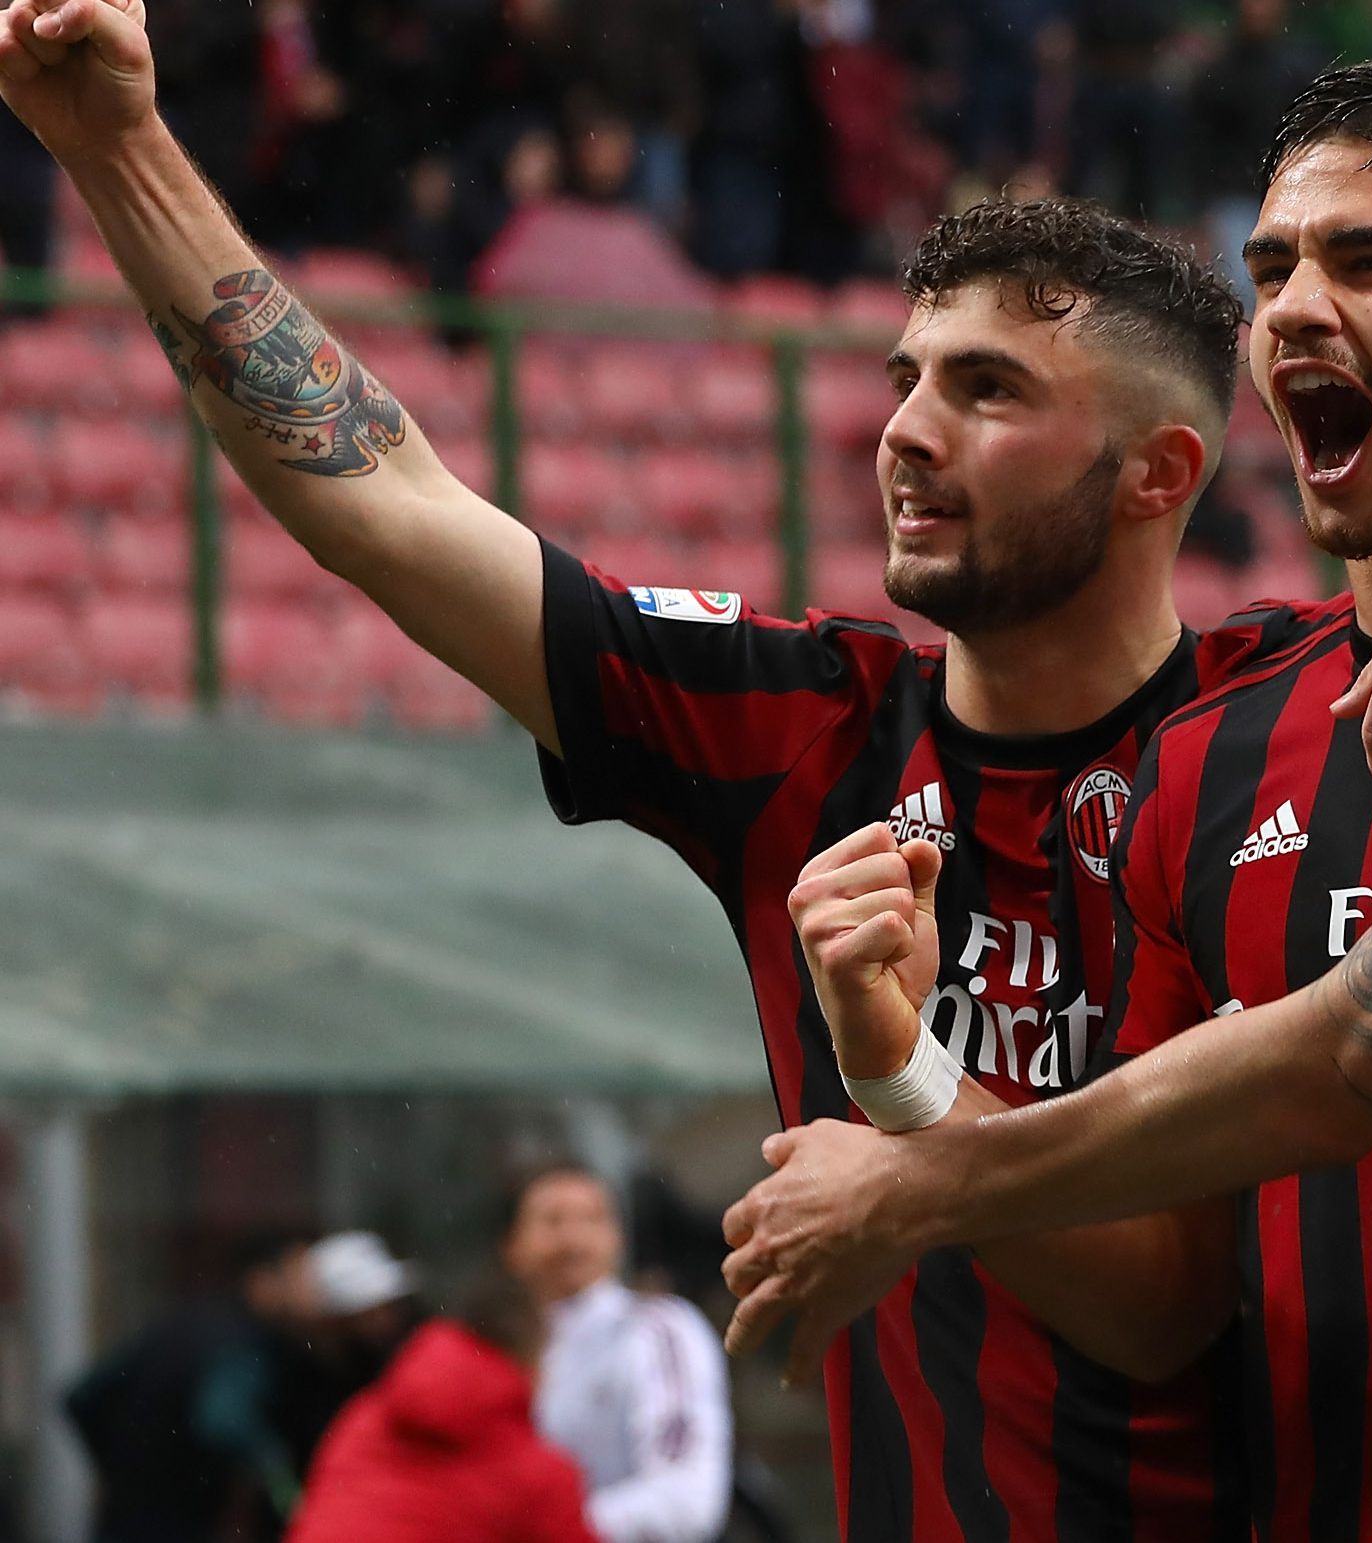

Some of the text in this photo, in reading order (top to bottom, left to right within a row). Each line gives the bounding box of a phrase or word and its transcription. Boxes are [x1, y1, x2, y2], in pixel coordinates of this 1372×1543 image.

[1081, 773, 1123, 800] ACM
[886, 816, 956, 851] didas
[1229, 833, 1309, 867] adidas
